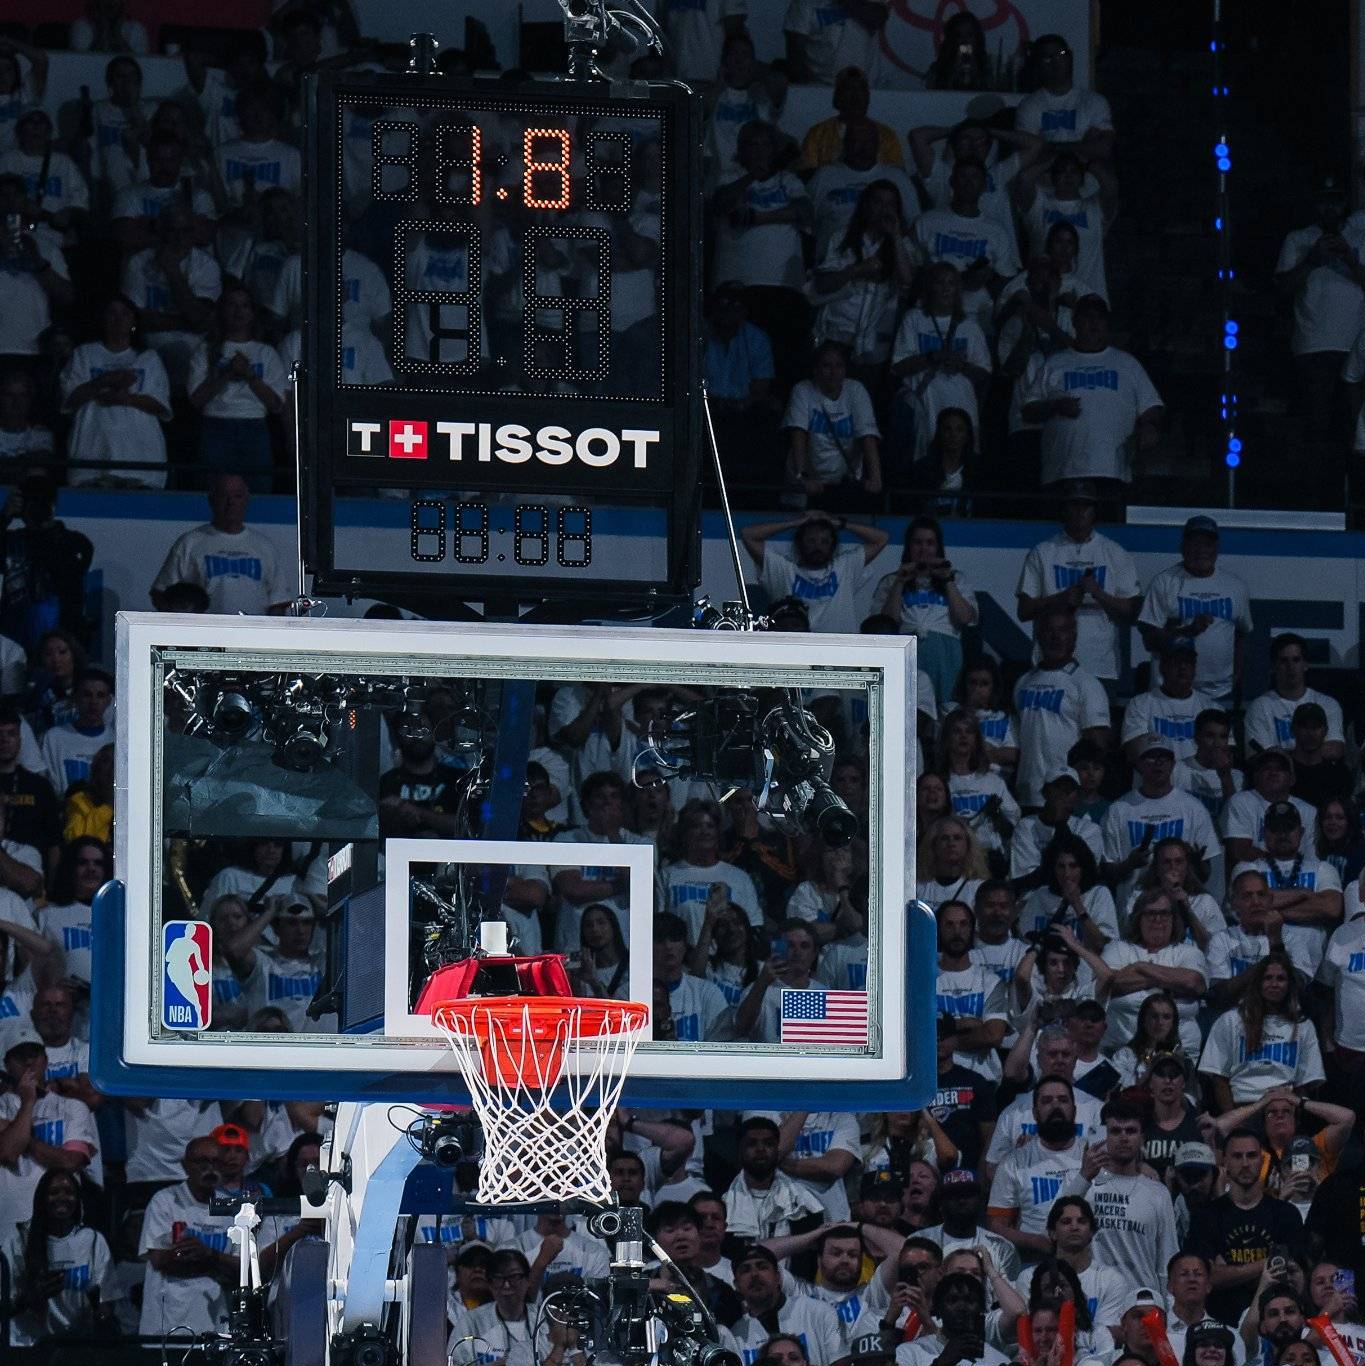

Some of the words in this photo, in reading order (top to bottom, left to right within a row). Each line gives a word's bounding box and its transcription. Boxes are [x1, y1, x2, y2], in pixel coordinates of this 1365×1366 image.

[437, 421, 660, 468] TISSOT
[168, 1004, 193, 1025] NBA
[1094, 1192, 1130, 1204] INDIANA
[1094, 1204, 1127, 1217] PACERS
